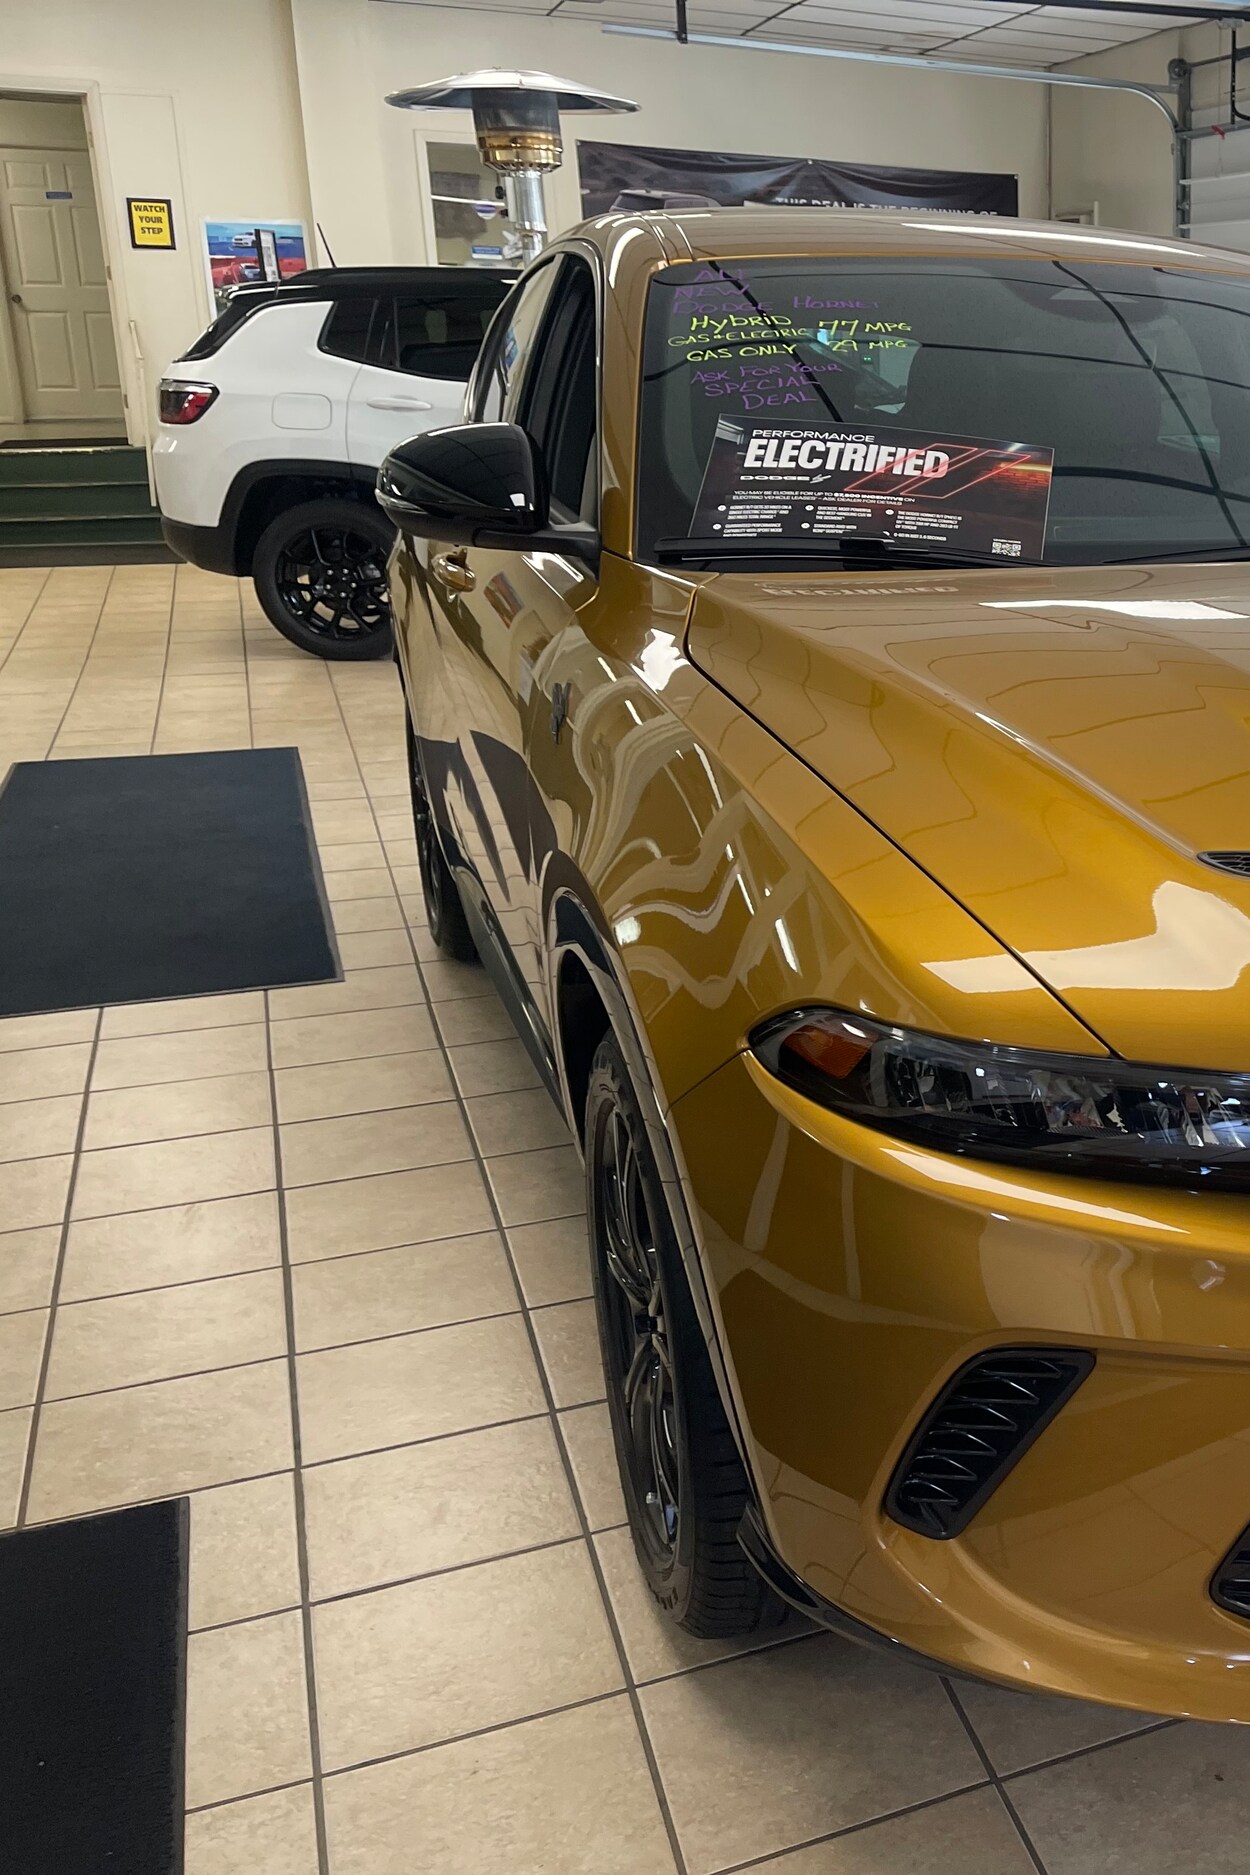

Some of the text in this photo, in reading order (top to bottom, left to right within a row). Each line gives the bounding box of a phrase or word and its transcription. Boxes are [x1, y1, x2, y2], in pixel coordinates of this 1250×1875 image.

[133, 204, 166, 213] WATCH
[138, 215, 163, 224] YOUR
[140, 226, 163, 235] STEP
[674, 284, 750, 299] NEW
[672, 300, 773, 314] DODGE
[818, 319, 859, 336] 77
[864, 321, 912, 333] MPG
[686, 343, 798, 362] GAS ONLY
[828, 339, 858, 353] 29
[868, 340, 908, 350] MPG
[690, 361, 843, 385] ASK FOR YOUR
[704, 375, 821, 397] SPECIAL
[742, 390, 817, 410] DEAL
[752, 429, 875, 443] PERFORMANCE
[743, 438, 950, 479] ELECTRIFIED
